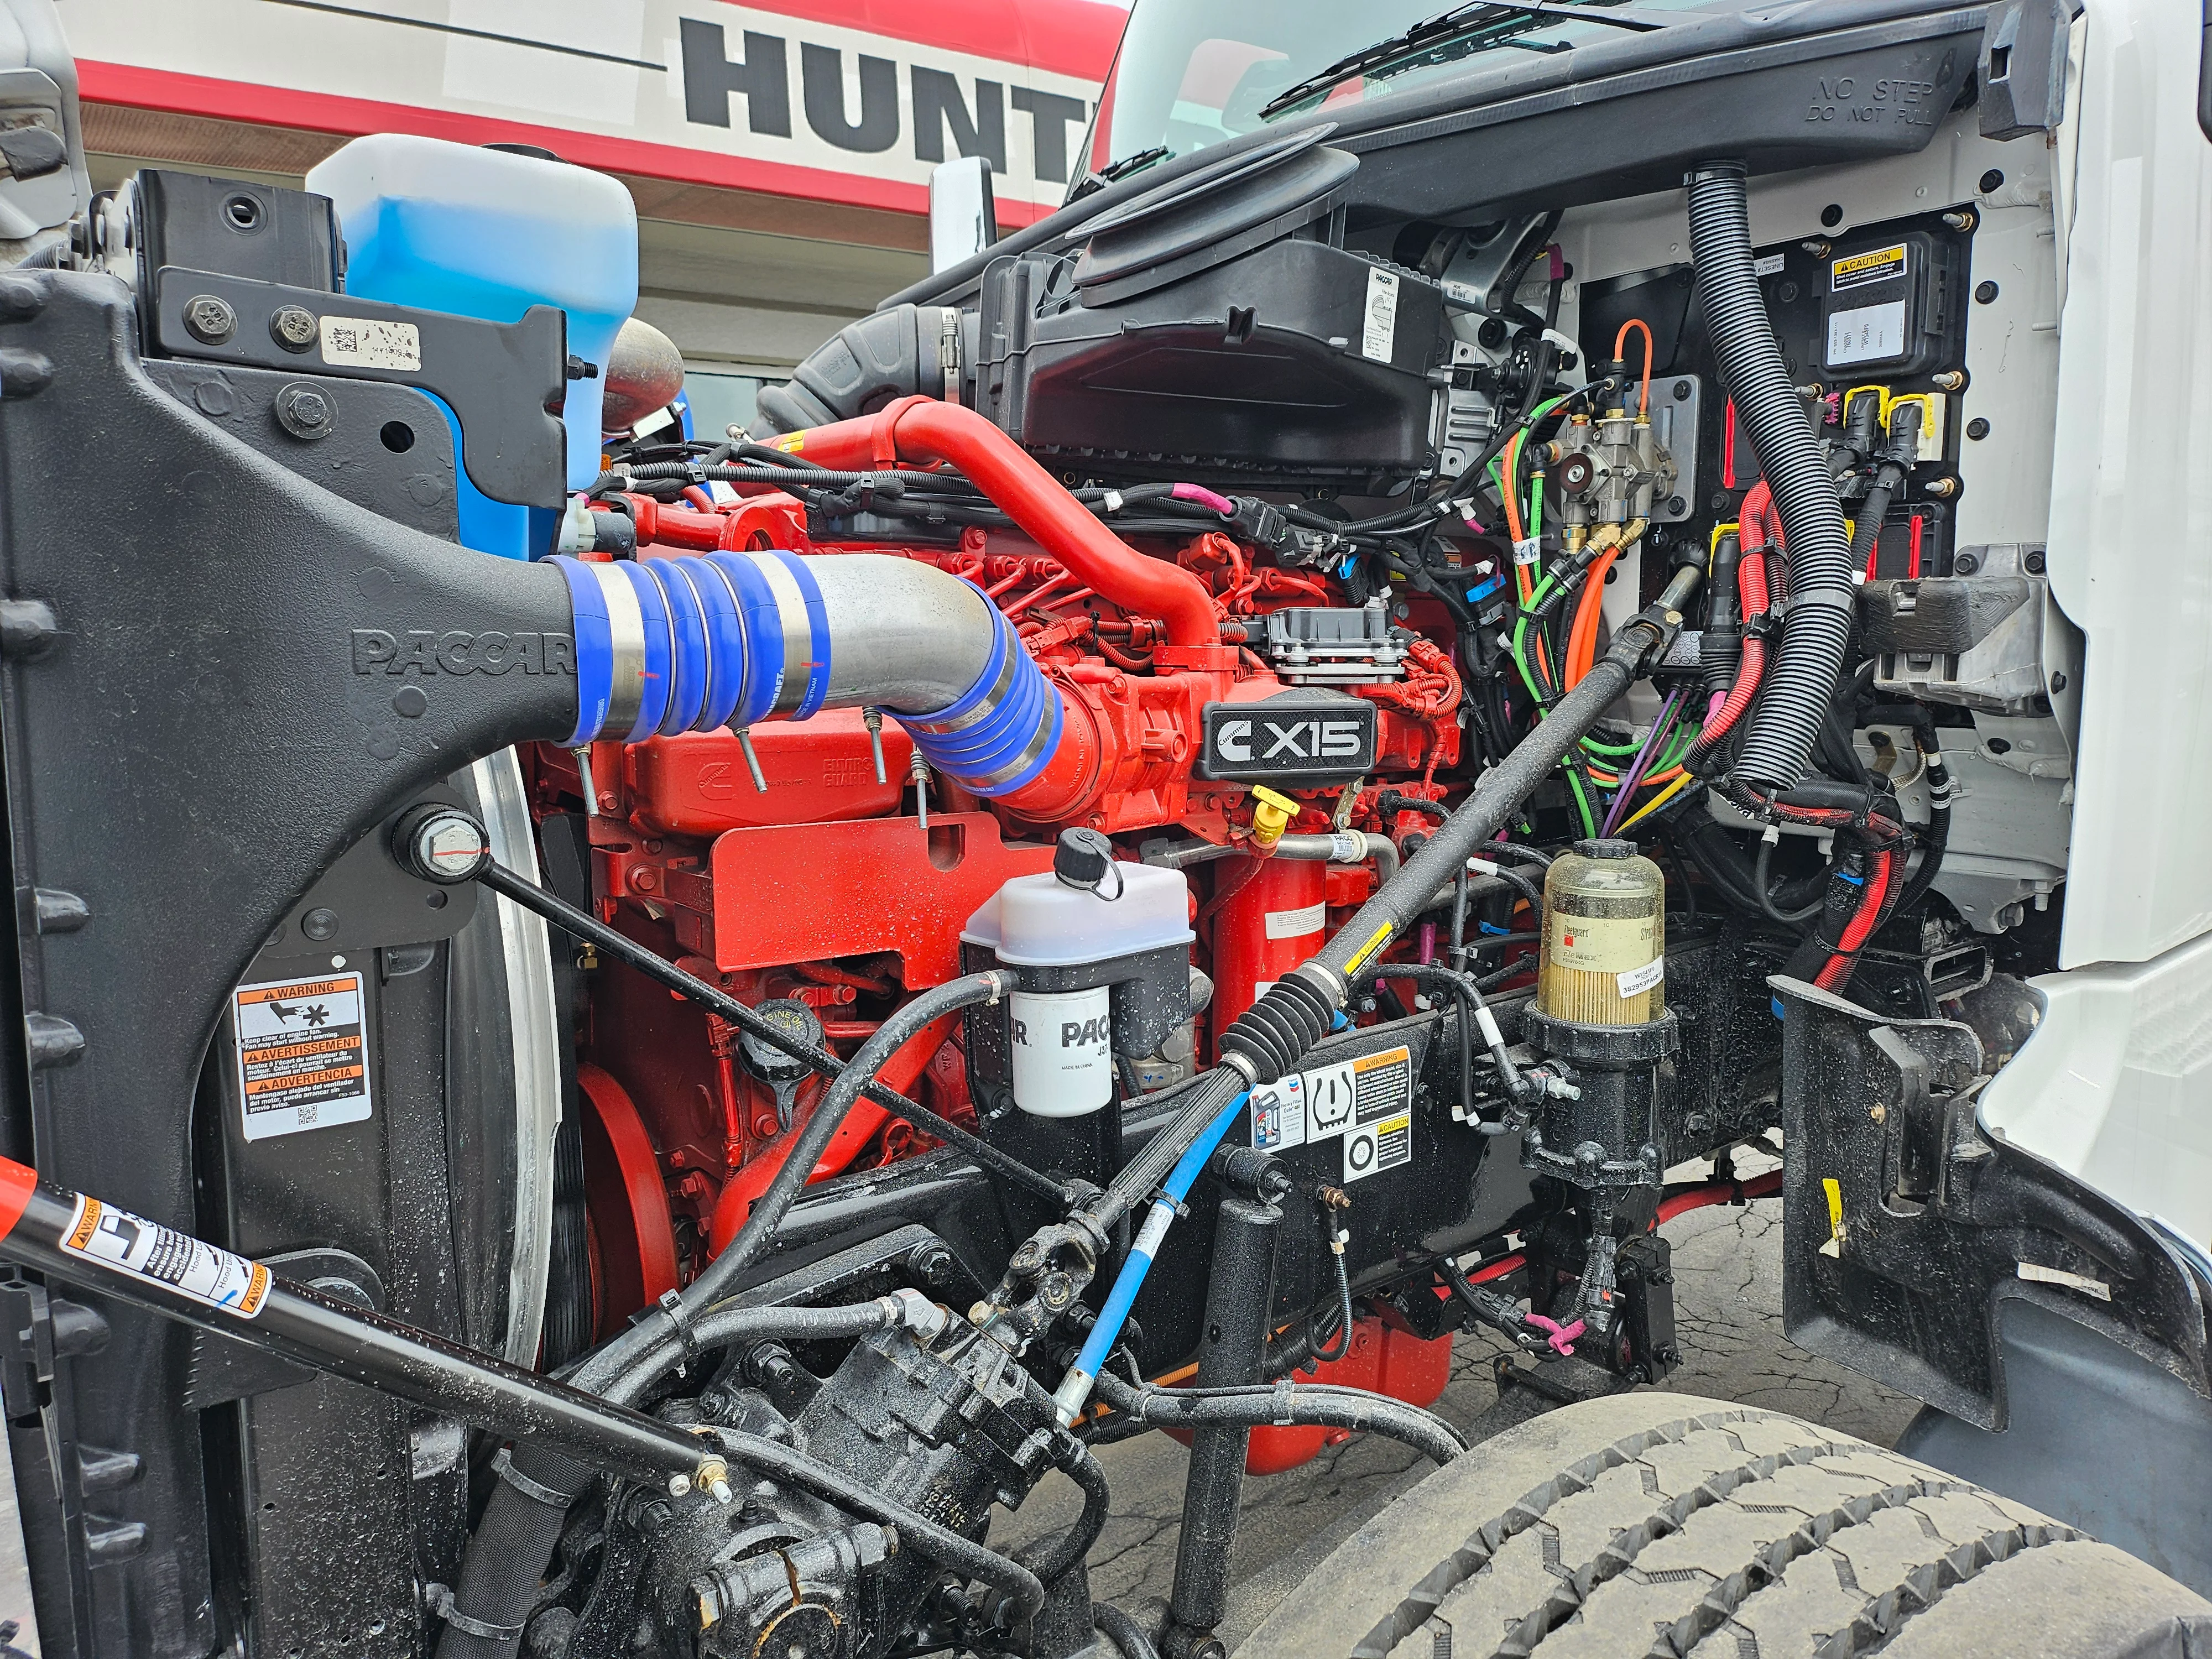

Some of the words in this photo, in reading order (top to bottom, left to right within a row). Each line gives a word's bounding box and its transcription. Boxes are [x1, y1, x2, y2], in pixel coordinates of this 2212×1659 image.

[1812, 77, 1854, 100] NO
[1873, 79, 1933, 104] STEP
[679, 17, 1086, 184] HUNT
[1805, 106, 1835, 122] DO
[1848, 106, 1886, 122] NOT
[1895, 108, 1932, 126] PULL
[1850, 253, 1890, 269] CAUTION
[1880, 263, 1895, 271] Engage
[1376, 273, 1392, 286] PACCAR
[351, 629, 577, 676] PACCAR
[807, 678, 817, 702] VIETNAM
[1218, 721, 1249, 747] Cummins
[1262, 721, 1360, 758] X15
[1564, 925, 1589, 938] Fleetguard
[1365, 936, 1379, 952] CAUTION
[278, 983, 334, 998] WARNING
[766, 1011, 792, 1021] GINE
[792, 1016, 804, 1030] OIL
[287, 1031, 309, 1040] engine
[289, 1036, 312, 1045] without
[312, 1032, 340, 1041] warning.
[262, 1037, 358, 1060] AVERTISSEMENT
[305, 1052, 338, 1061] ventilateur
[299, 1060, 324, 1070] pourrait
[1370, 1053, 1397, 1066] WARNING
[247, 1070, 291, 1081] soudainement
[272, 1068, 352, 1089] ADVERTENCIA
[249, 1090, 288, 1101] Mantengase
[289, 1086, 311, 1095] alejado
[323, 1079, 354, 1088] ventilador
[283, 1093, 302, 1102] puede
[250, 1105, 270, 1114] previo
[1384, 1118, 1408, 1131] CAUTION
[147, 1246, 163, 1269] After
[154, 1245, 173, 1276] ensure
[163, 1243, 183, 1279] engaged
[174, 1239, 192, 1280] accidental
[189, 1252, 202, 1272] Hood
[218, 1267, 231, 1288] Hood
